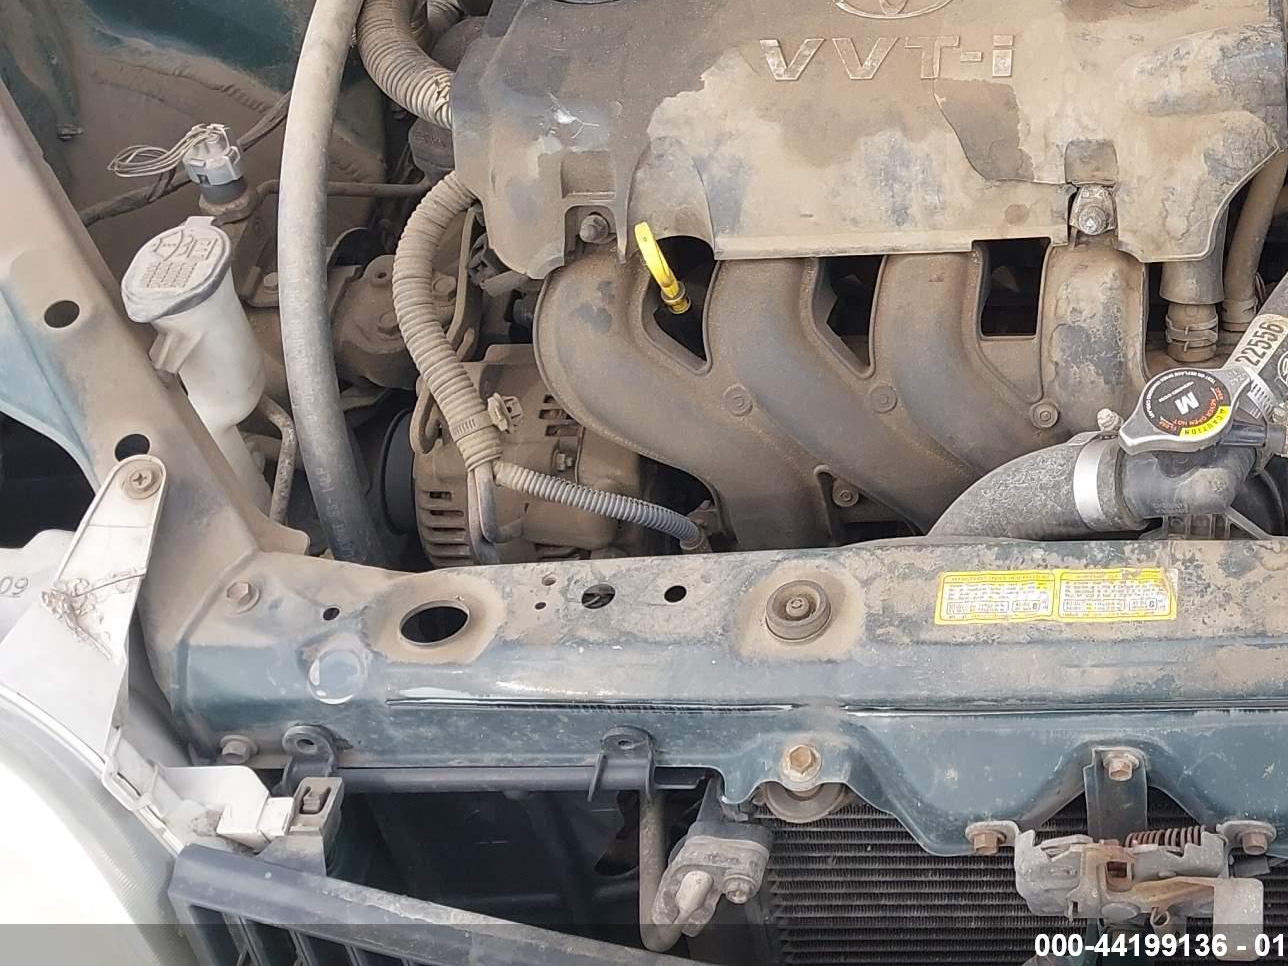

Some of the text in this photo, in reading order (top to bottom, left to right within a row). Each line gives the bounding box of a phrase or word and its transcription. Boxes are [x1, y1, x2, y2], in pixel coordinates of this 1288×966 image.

[759, 35, 1015, 81] VVT-i
[1234, 321, 1285, 367] 22556
[1174, 391, 1199, 415] M
